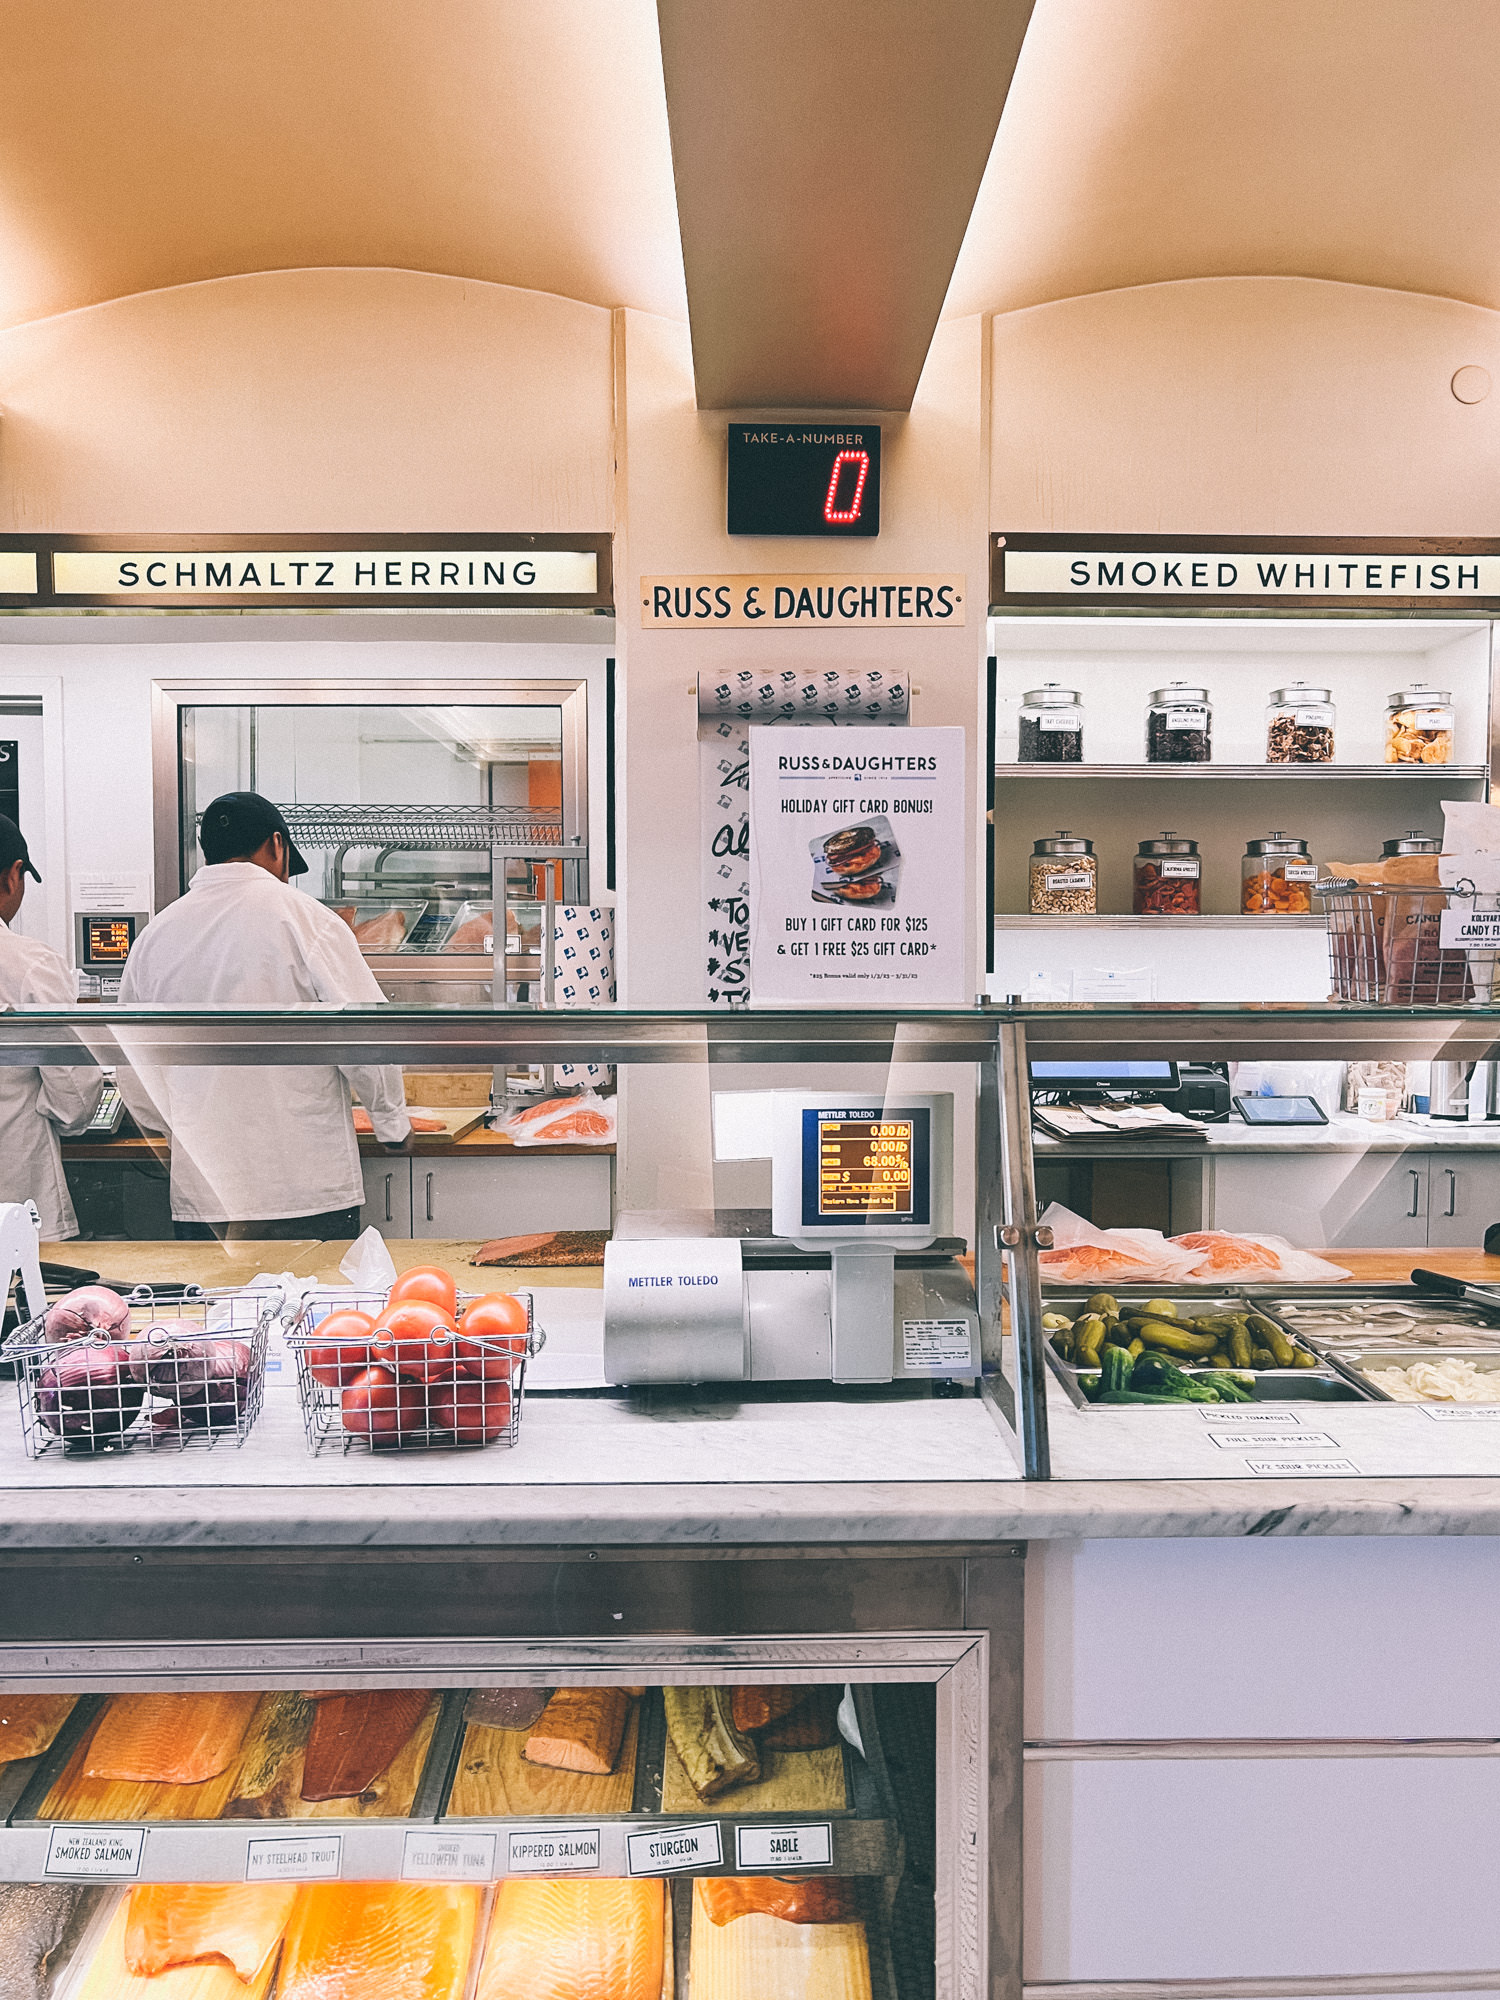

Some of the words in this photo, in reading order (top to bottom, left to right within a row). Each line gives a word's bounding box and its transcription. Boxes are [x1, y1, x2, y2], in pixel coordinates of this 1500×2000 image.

[743, 433, 863, 445] TAKE-A-NUMBER
[825, 450, 869, 522] 0
[118, 562, 335, 588] SCHMALTZ
[355, 561, 537, 586] HERRING
[1070, 561, 1238, 587] SMOKED
[1257, 563, 1479, 589] WHITEFISH
[653, 586, 731, 618] RUSS
[743, 587, 766, 618] &
[774, 586, 955, 618] DAUGHTERS
[781, 799, 827, 813] HOLIDAY
[833, 799, 855, 813] GIFT
[860, 799, 888, 813] CARD
[893, 799, 933, 813] BONUS!
[785, 918, 807, 931] BUY
[812, 918, 817, 931] 1
[821, 918, 843, 931] GIFT
[847, 918, 876, 931] CARD
[881, 918, 900, 931] FOR
[905, 916, 928, 932] $125
[1461, 925, 1489, 935] CANDY
[777, 944, 786, 955] &
[791, 942, 809, 955] GET
[815, 942, 819, 955] 1
[823, 942, 846, 955] FREE
[851, 941, 869, 957] $25
[874, 942, 896, 955] GIFT
[870, 1125, 895, 1136] 0.00
[896, 1126, 908, 1136] lb
[870, 1141, 895, 1152] 0.00
[895, 1141, 908, 1152] lb
[863, 1156, 895, 1167] 68.00
[842, 1171, 850, 1182] $
[883, 1171, 908, 1181] 0.00
[628, 1277, 672, 1287] METTLER
[678, 1276, 719, 1286] TOLEDO
[82, 1838, 107, 1847] ZEALAND
[109, 1838, 124, 1847] KING
[649, 1838, 699, 1858] STURGEON
[770, 1838, 799, 1853] SABLE
[55, 1847, 91, 1860] SMOKED
[94, 1848, 132, 1861] SALMON
[512, 1844, 555, 1858] KIPPERED
[559, 1842, 597, 1856] SALMON
[252, 1854, 263, 1865] NY
[267, 1852, 308, 1864] STEELHEAD
[311, 1850, 336, 1862] TROUT
[412, 1853, 458, 1866] YELLOWFIN
[463, 1854, 486, 1866] TUNA
